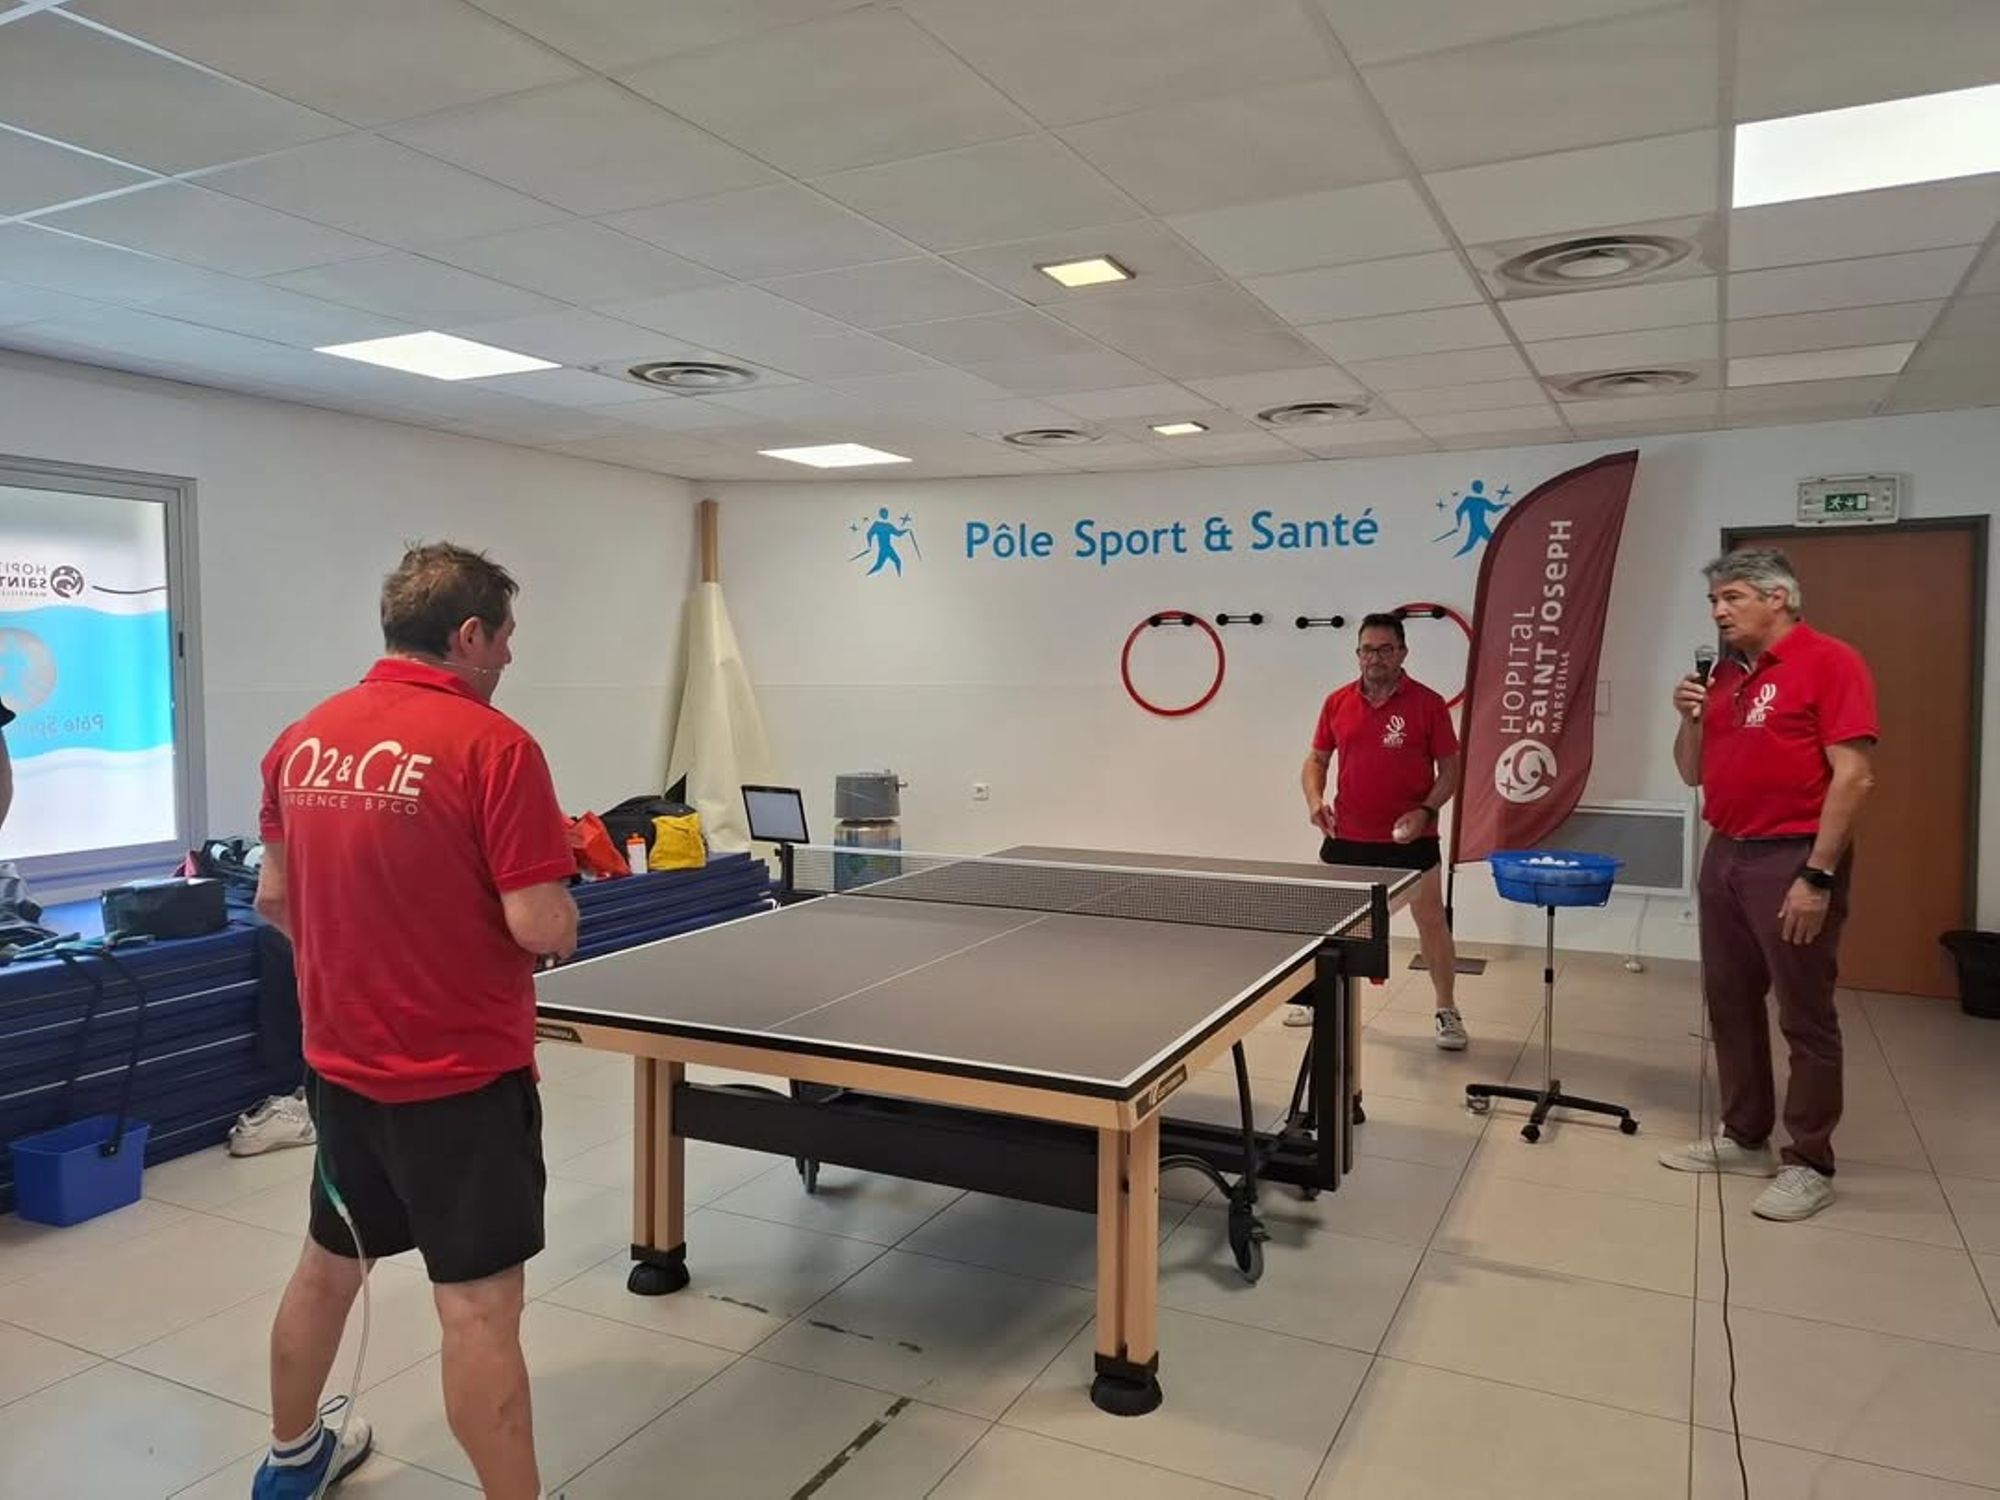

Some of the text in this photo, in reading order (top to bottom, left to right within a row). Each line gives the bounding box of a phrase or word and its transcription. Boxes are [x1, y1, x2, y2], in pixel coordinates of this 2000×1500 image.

[966, 508, 1379, 565] Pôle Sport & Santé
[283, 793, 418, 815] RGENCE BPCO
